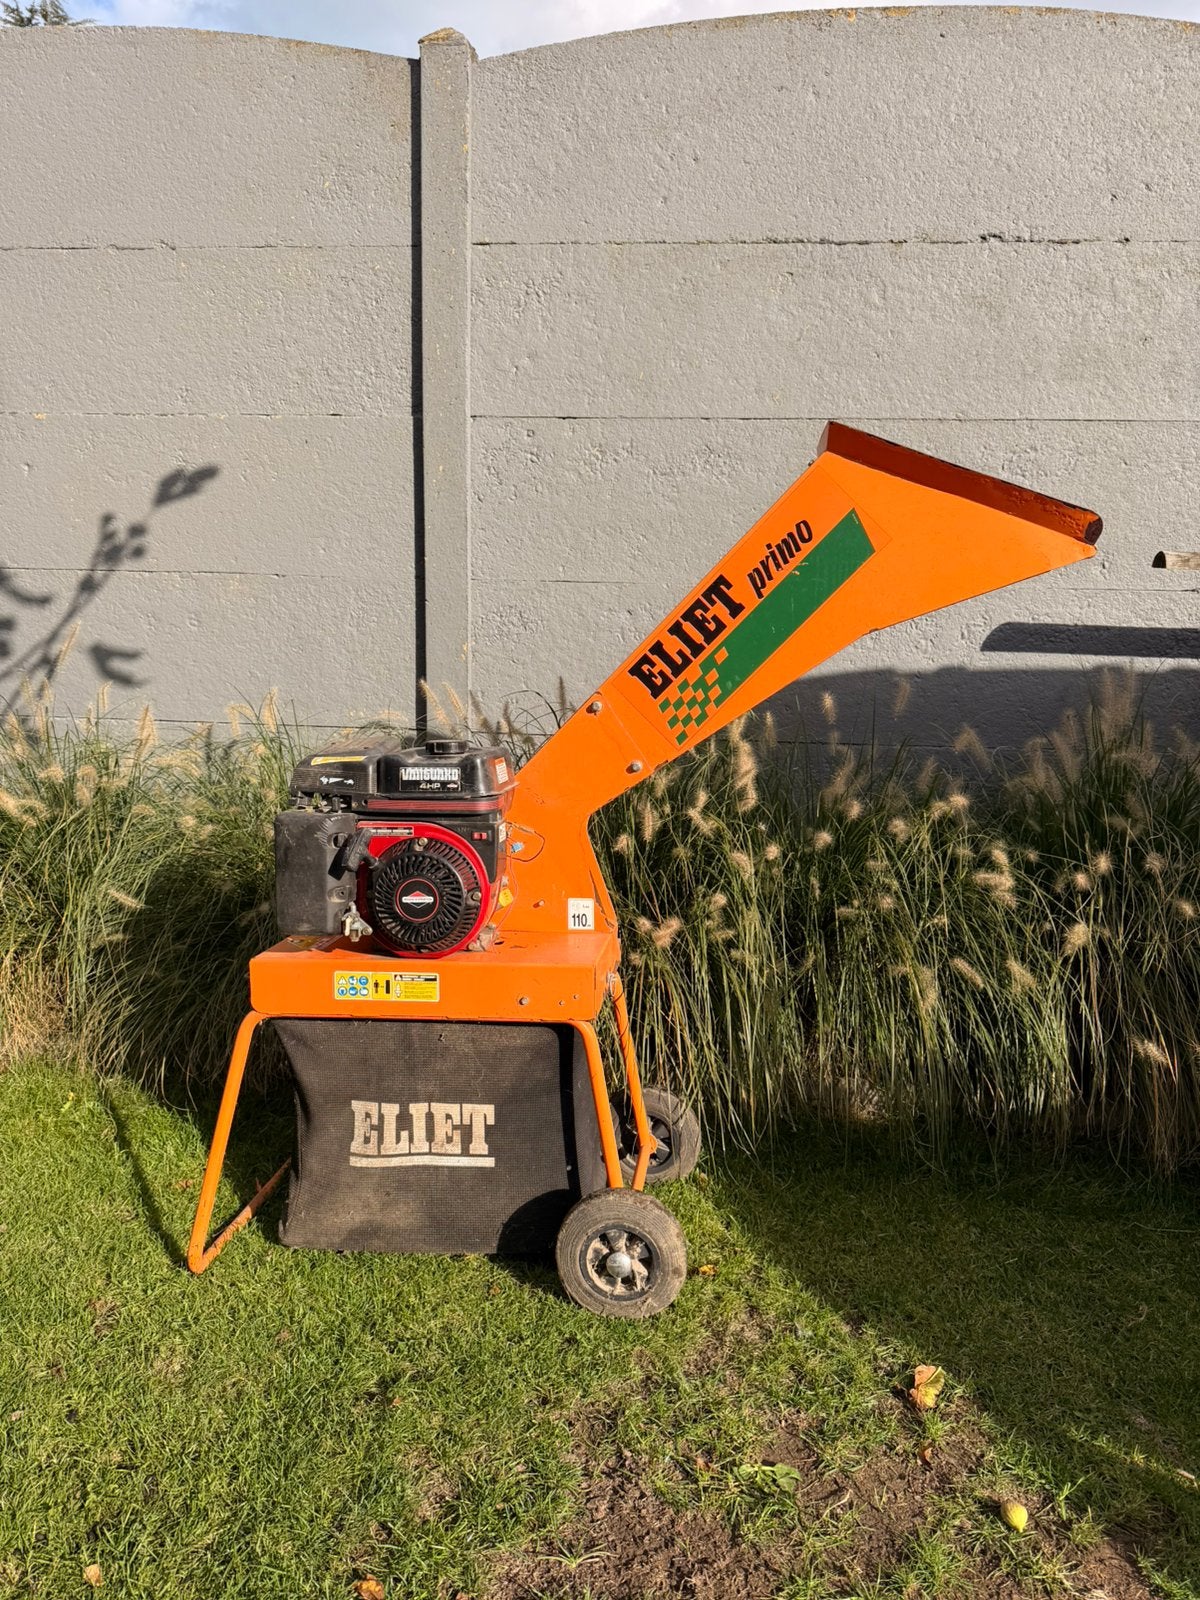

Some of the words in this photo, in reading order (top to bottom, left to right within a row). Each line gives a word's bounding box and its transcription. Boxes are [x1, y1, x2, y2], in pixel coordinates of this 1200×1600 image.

[627, 574, 746, 700] ELIET
[747, 519, 814, 599] primo
[401, 767, 459, 781] VANGUARD
[571, 913, 588, 927] 110
[350, 1100, 495, 1156] ELIET
